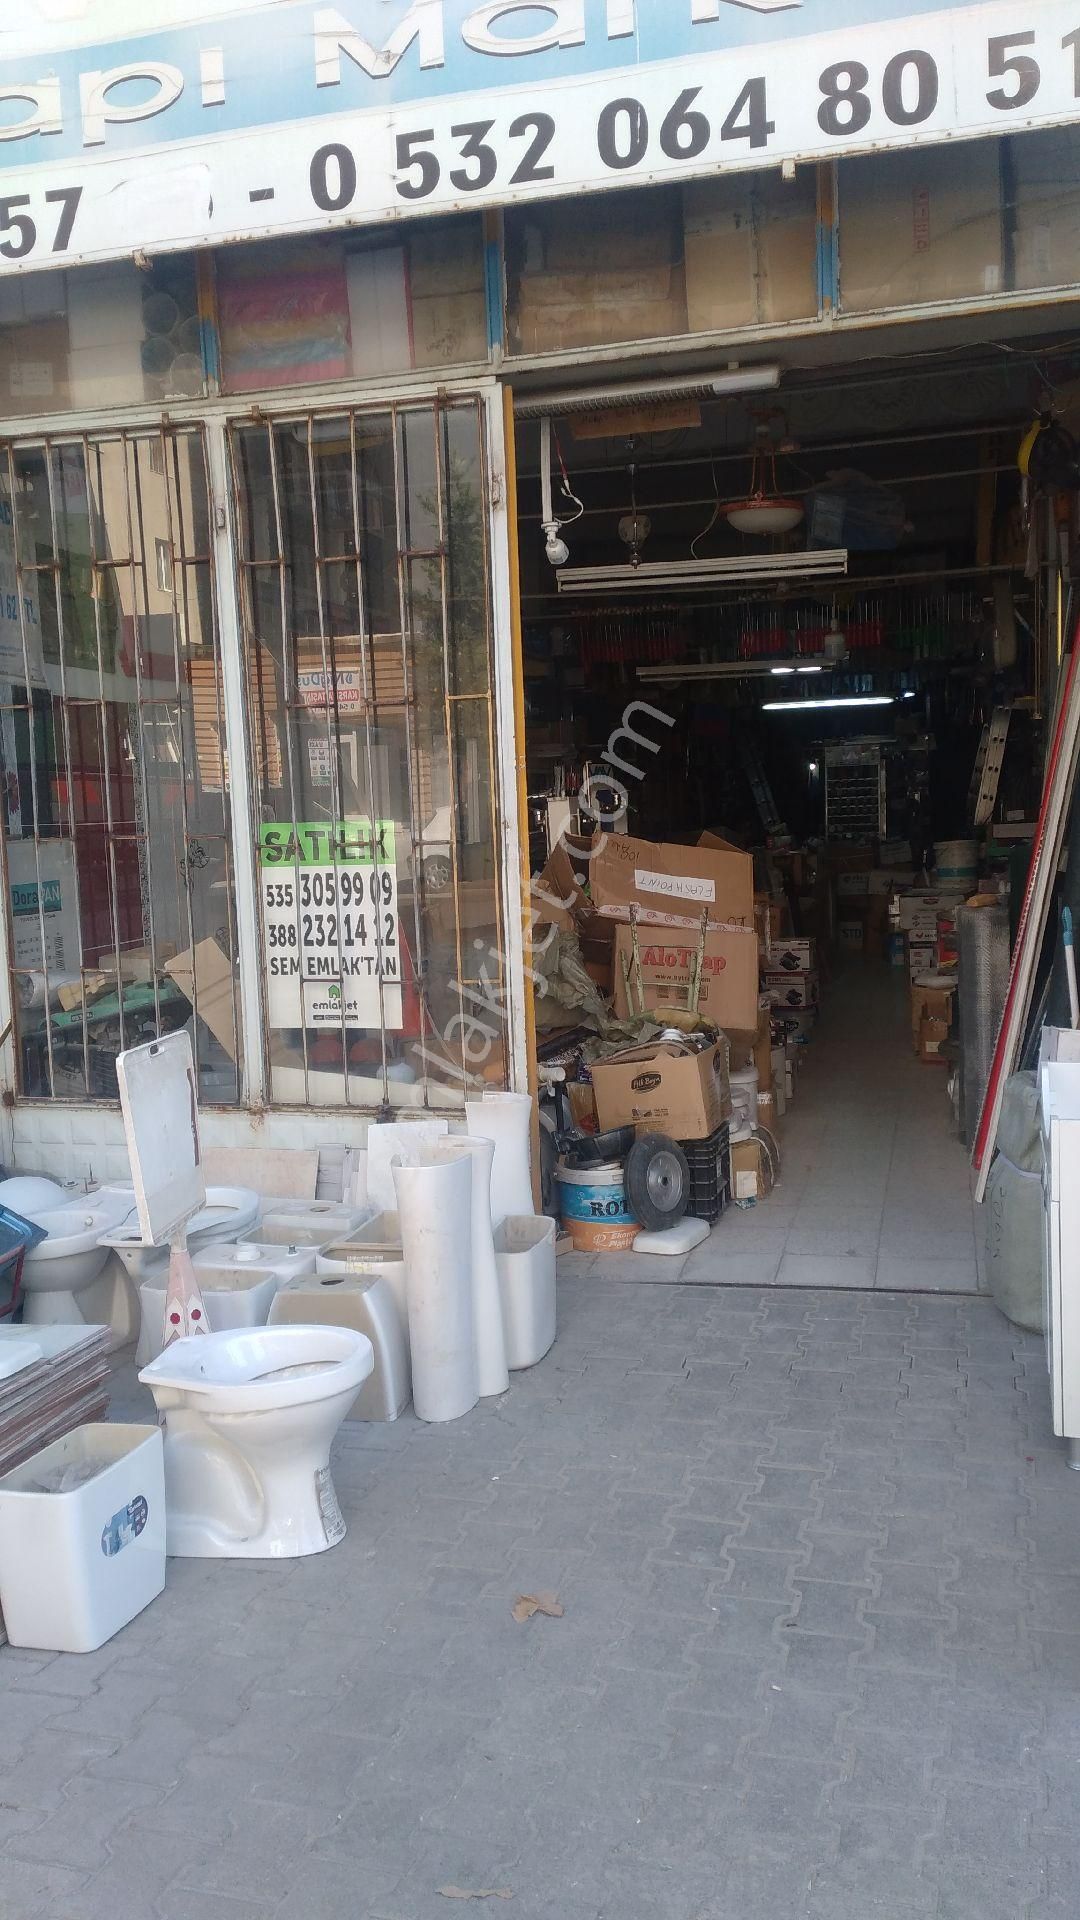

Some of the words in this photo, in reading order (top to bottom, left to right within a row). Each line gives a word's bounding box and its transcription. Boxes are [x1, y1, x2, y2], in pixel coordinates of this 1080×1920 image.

[310, 143, 357, 211] 0
[396, 113, 556, 199] 532
[597, 77, 775, 169] 064
[816, 49, 939, 136] 80
[266, 884, 293, 907] 535
[300, 872, 336, 907] 305
[341, 871, 364, 907] 99
[268, 924, 297, 948] 388
[303, 913, 338, 947] 232
[344, 913, 367, 947] 14
[270, 956, 300, 976] SEM
[642, 947, 727, 975] AloTap
